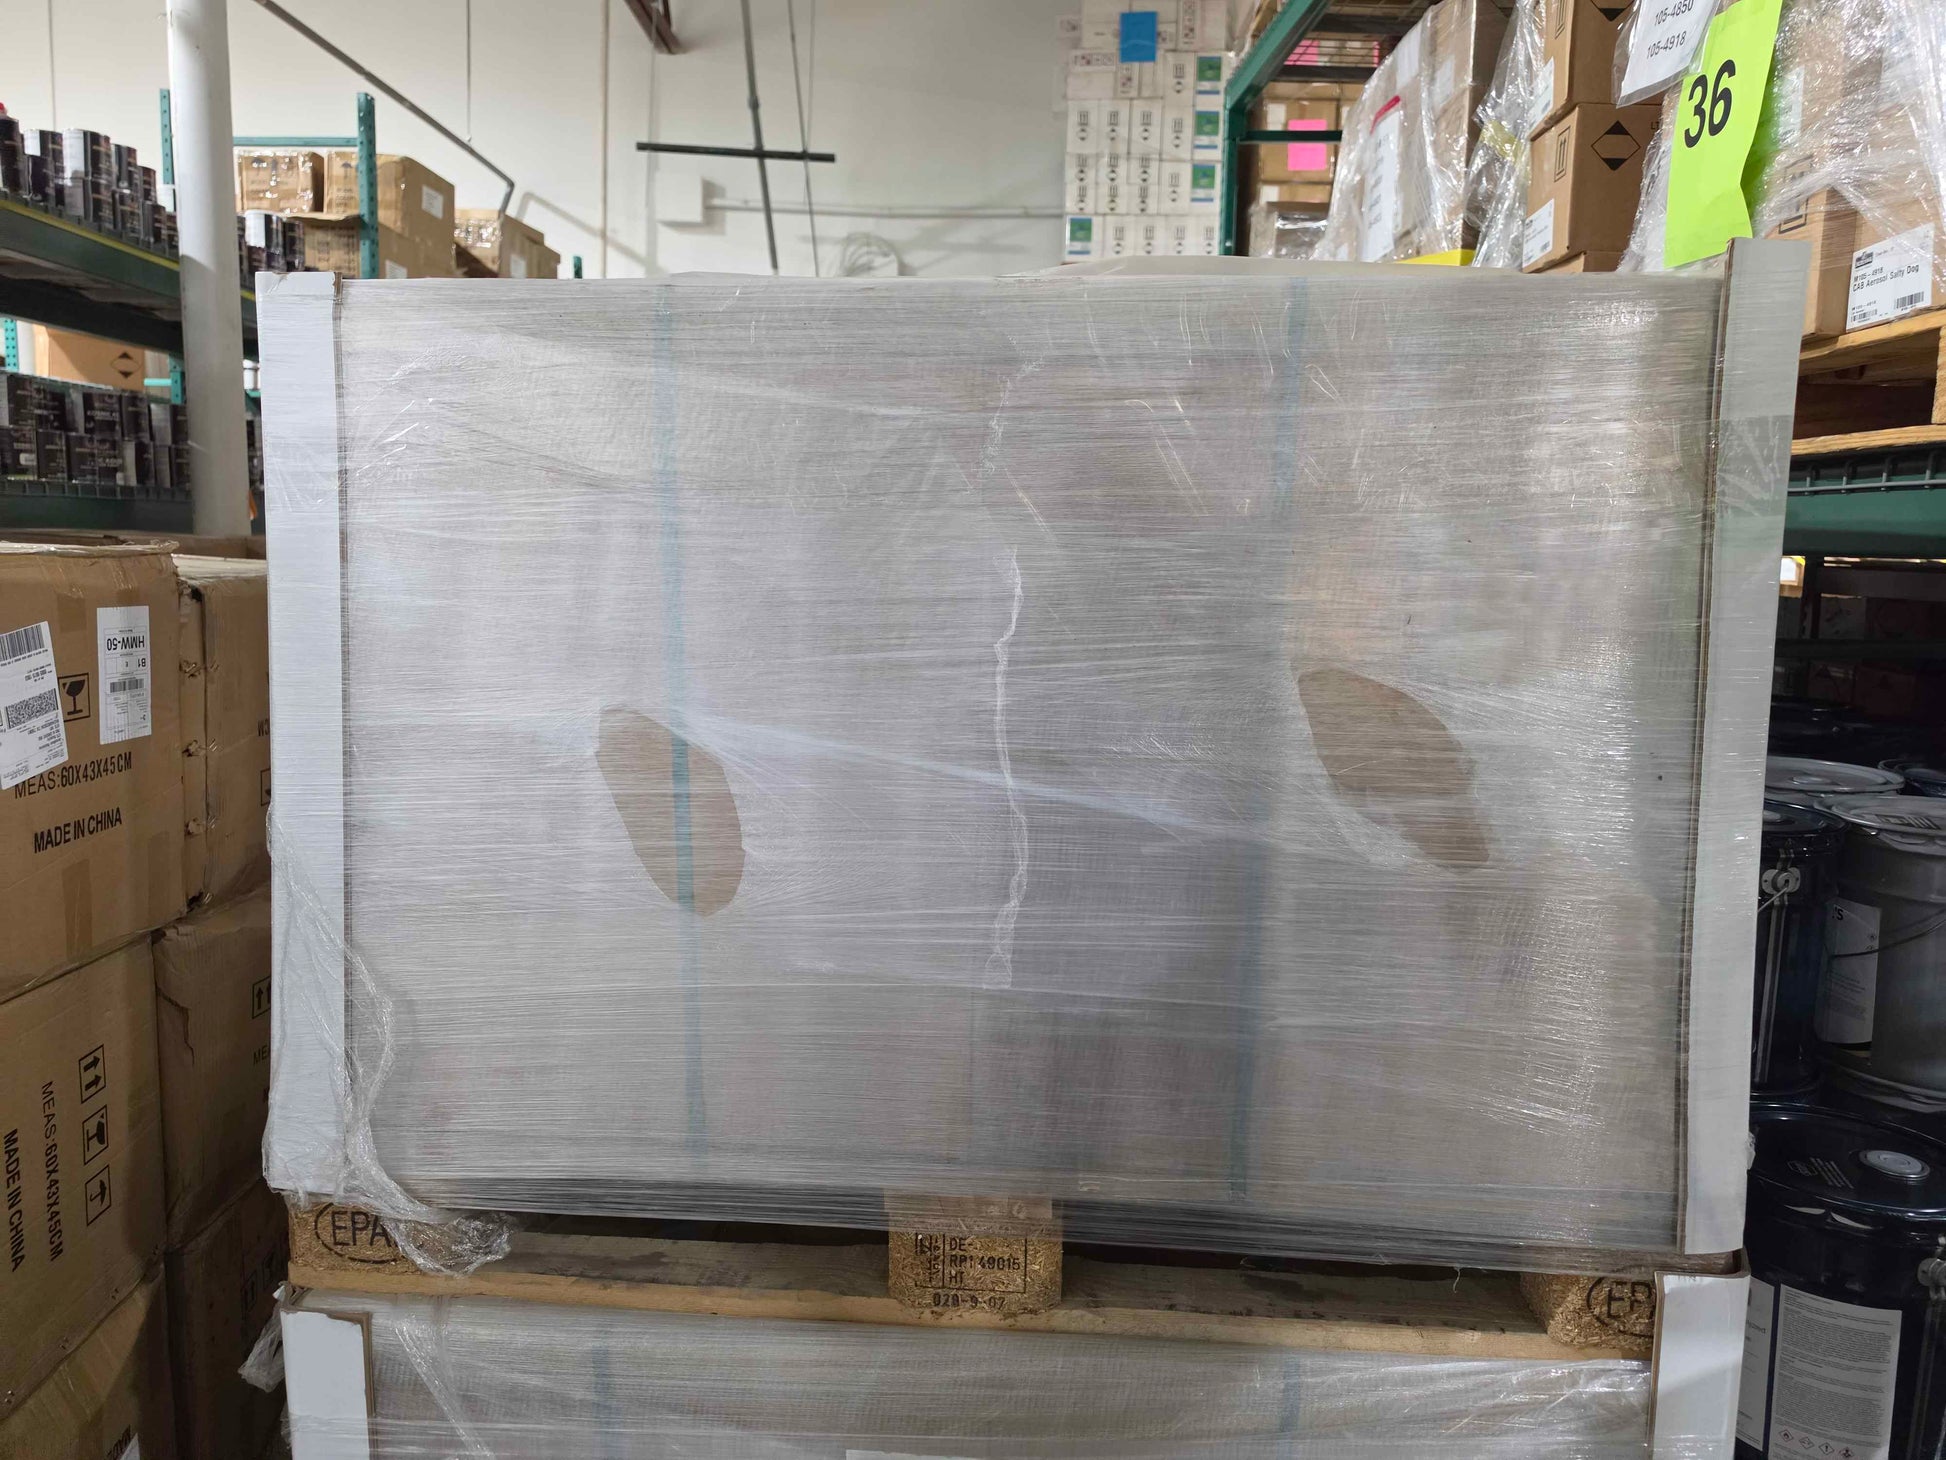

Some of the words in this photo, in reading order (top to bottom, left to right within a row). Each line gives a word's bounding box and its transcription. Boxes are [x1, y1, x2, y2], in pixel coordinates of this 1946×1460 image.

[1654, 0, 1694, 26] 105-4850
[1647, 31, 1687, 59] 105-4918
[1684, 59, 1736, 149] 36
[1907, 264, 1919, 274] Dog
[106, 635, 145, 651] HMW-50
[137, 658, 146, 667] B1
[34, 823, 71, 854] MADE
[74, 819, 85, 840] IN
[87, 807, 122, 835] CHINA
[4, 1128, 20, 1189] MADE
[7, 1186, 21, 1211] IN
[9, 1209, 25, 1272] CHINA
[330, 1210, 395, 1248] EPA
[1606, 1280, 1654, 1320] EP
